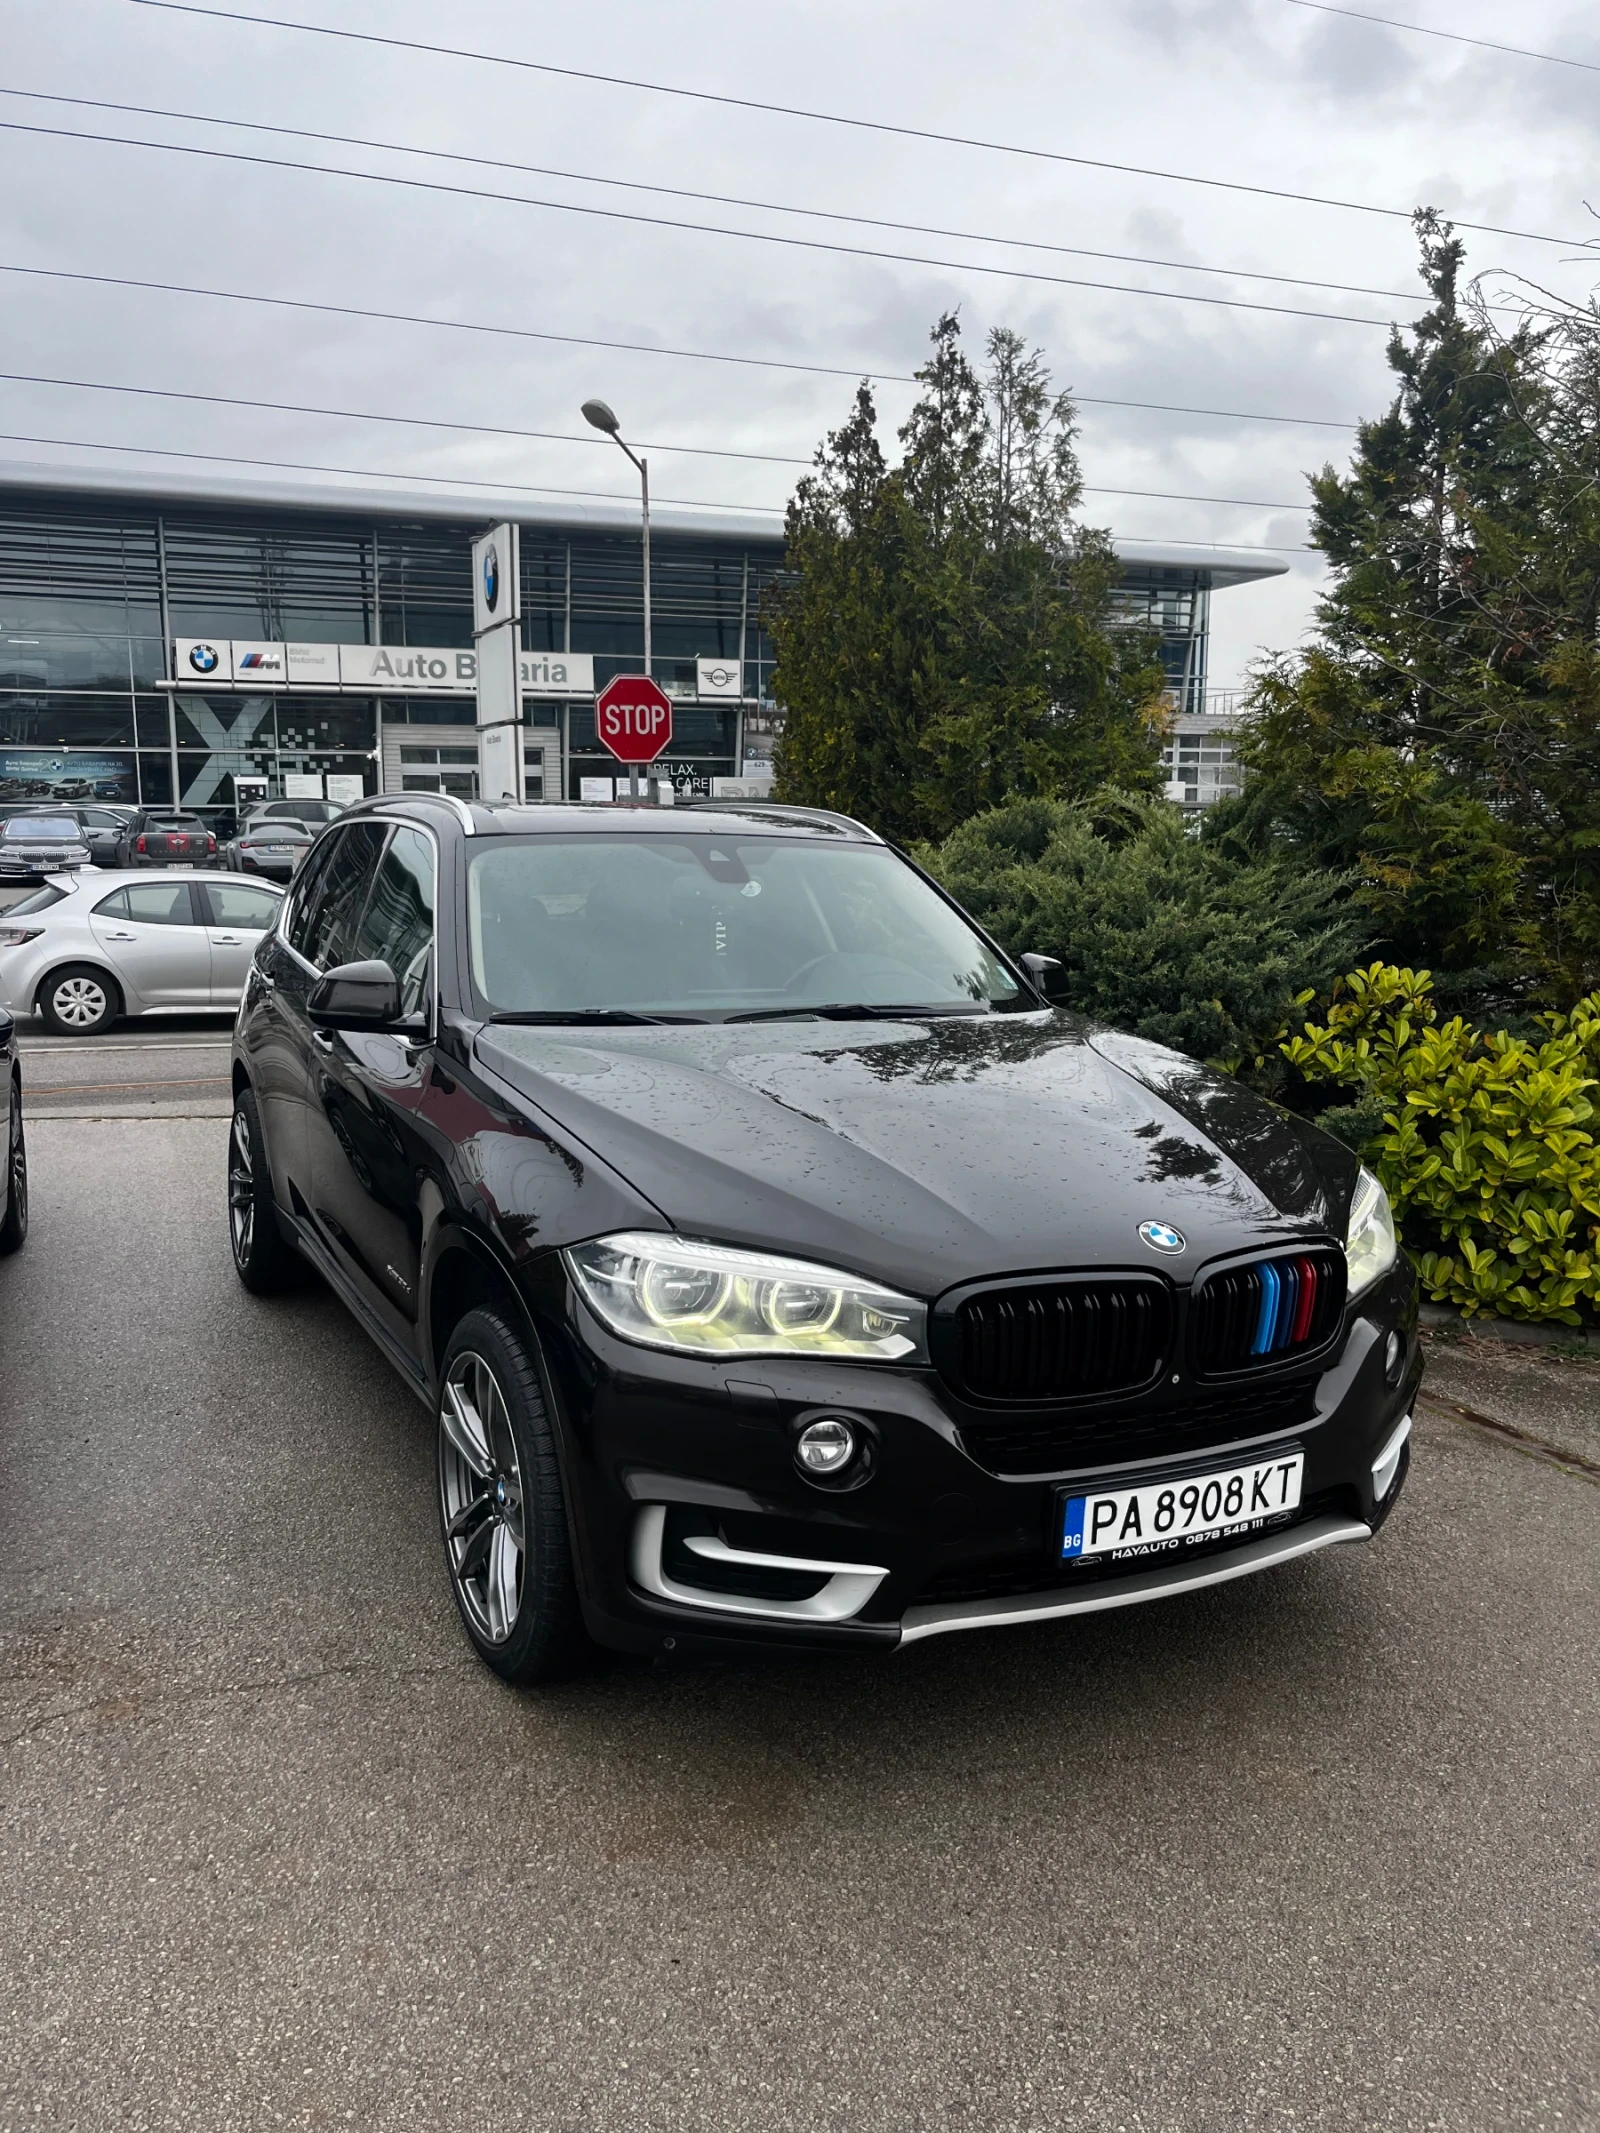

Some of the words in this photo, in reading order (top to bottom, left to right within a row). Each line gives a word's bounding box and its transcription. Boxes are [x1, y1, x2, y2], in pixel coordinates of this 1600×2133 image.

[372, 650, 447, 680] Auto
[605, 704, 665, 735] STOP
[715, 921, 727, 950] VIP
[1090, 1495, 1142, 1546] PA
[1153, 1475, 1244, 1533] 8908
[1250, 1461, 1297, 1512] KT
[1063, 1533, 1082, 1549] BG
[1111, 1538, 1179, 1560] HAYAUTO
[1185, 1530, 1220, 1546] 0878
[1223, 1523, 1249, 1537] 548
[1250, 1518, 1264, 1530] 111
